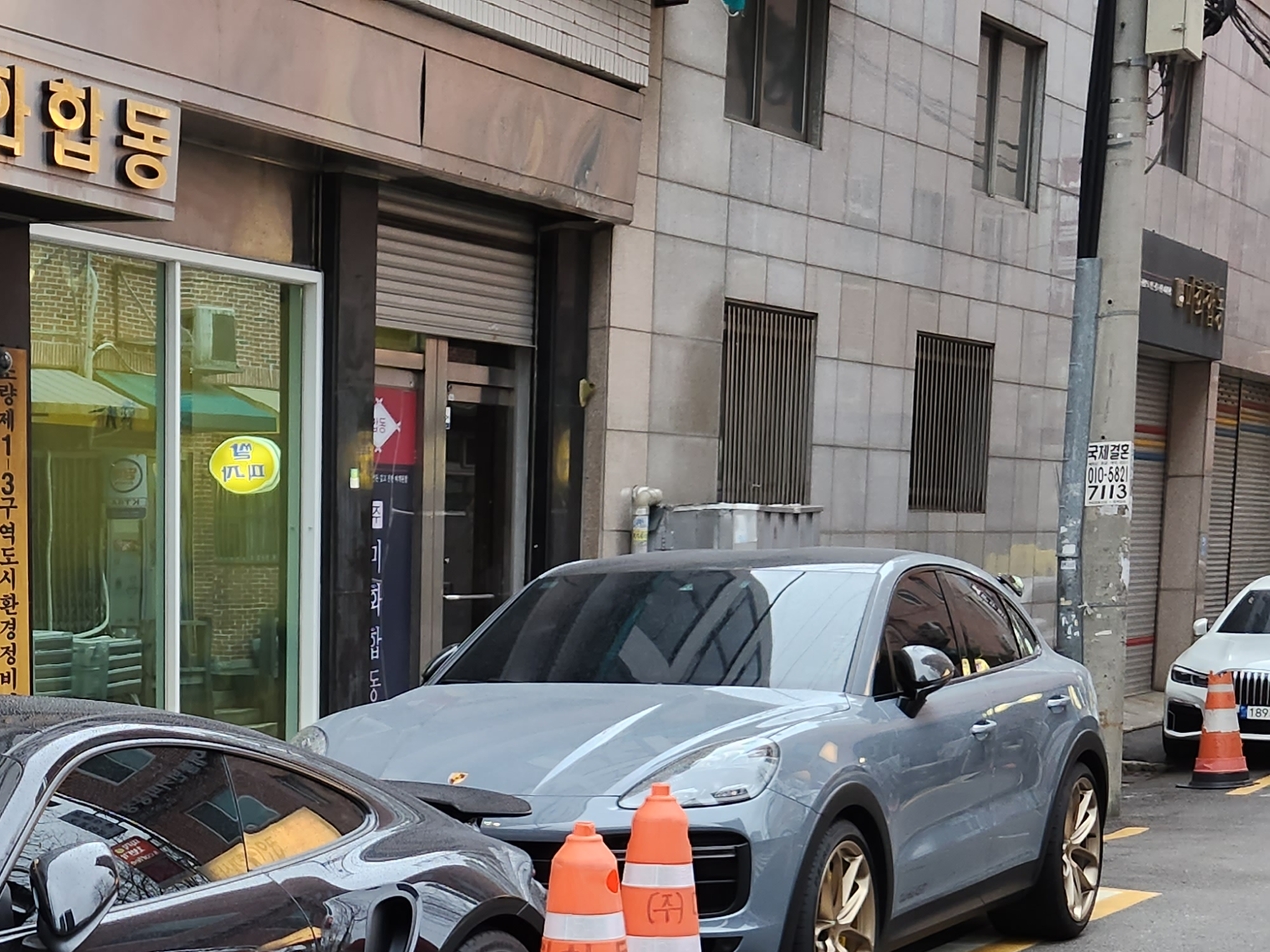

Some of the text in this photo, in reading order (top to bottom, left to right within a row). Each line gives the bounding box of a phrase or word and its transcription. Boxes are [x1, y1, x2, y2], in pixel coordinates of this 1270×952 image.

[1088, 444, 1129, 460] 국제결혼
[1088, 466, 1128, 483] 010-5821
[1088, 484, 1127, 500] 7113
